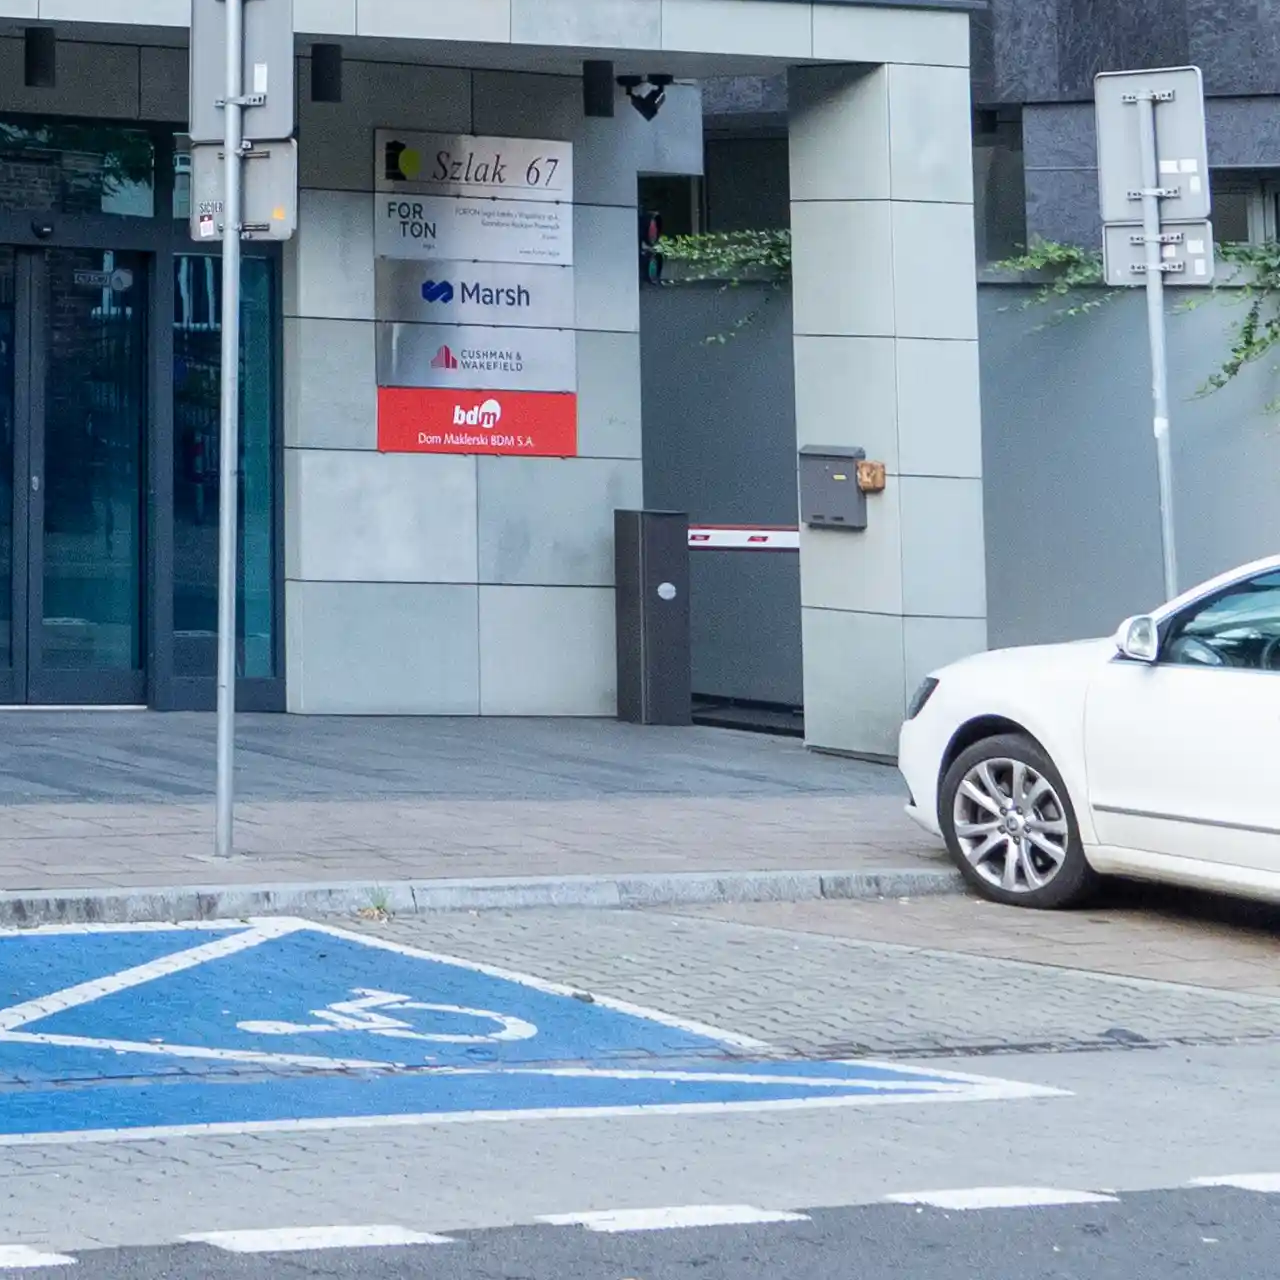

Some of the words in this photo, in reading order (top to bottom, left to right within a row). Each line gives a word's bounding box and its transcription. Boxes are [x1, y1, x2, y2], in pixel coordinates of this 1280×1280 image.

[432, 150, 508, 183] Szlak
[526, 157, 559, 187] 67
[388, 202, 423, 220] FOR
[400, 221, 436, 239] TON
[460, 282, 530, 306] Marsh
[460, 349, 513, 360] CUSHMAN
[515, 351, 522, 361] &
[460, 360, 523, 371] WAKEFIELD
[453, 399, 501, 428] bdm
[418, 432, 441, 444] Dom
[443, 433, 489, 445] Maklerski
[491, 435, 514, 446] BDM
